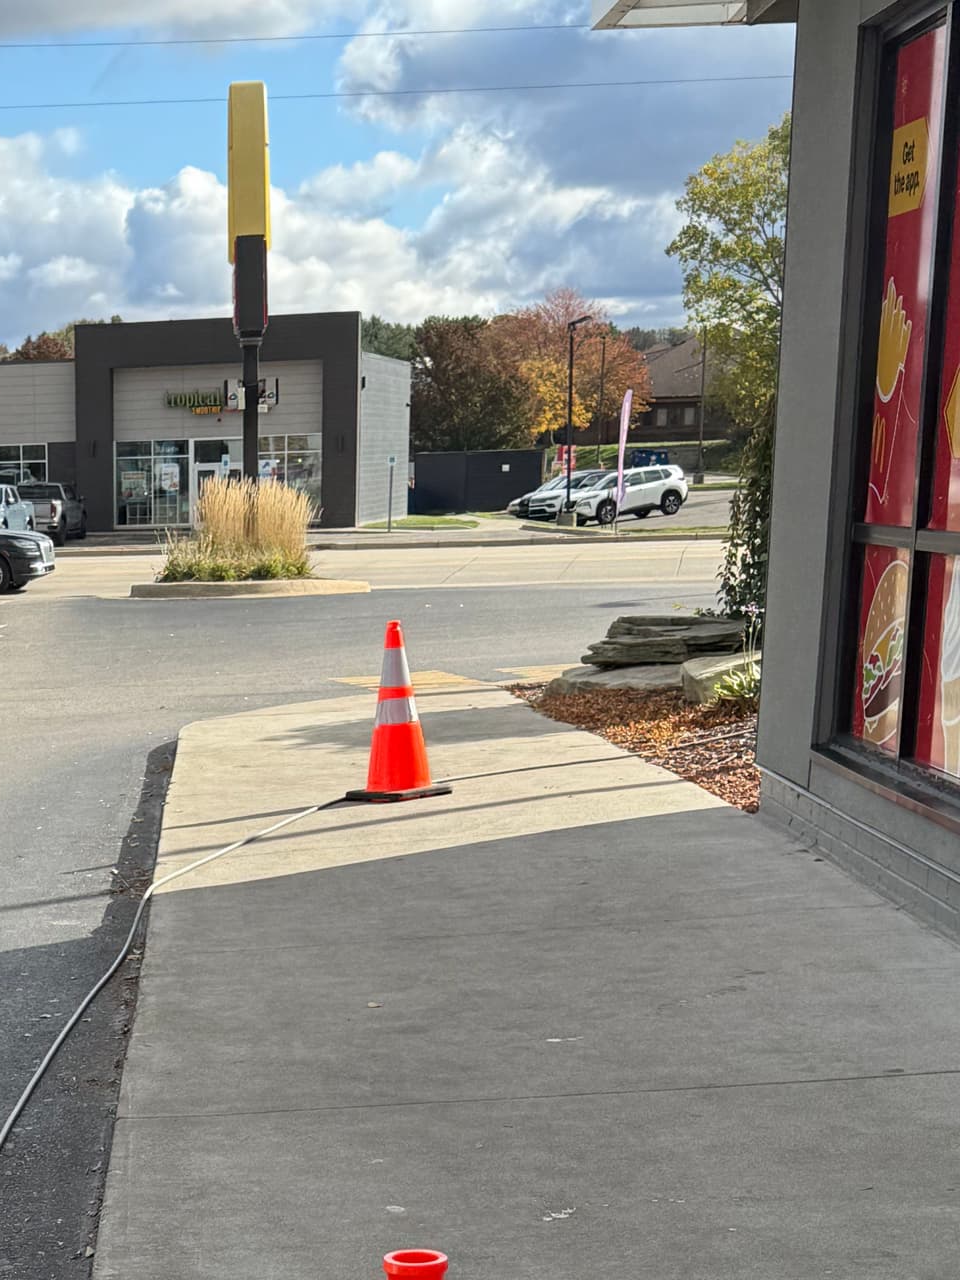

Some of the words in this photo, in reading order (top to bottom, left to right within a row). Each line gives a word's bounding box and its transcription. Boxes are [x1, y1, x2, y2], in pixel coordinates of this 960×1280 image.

[902, 138, 915, 165] Get
[894, 171, 905, 196] the
[164, 386, 222, 409] tropical
